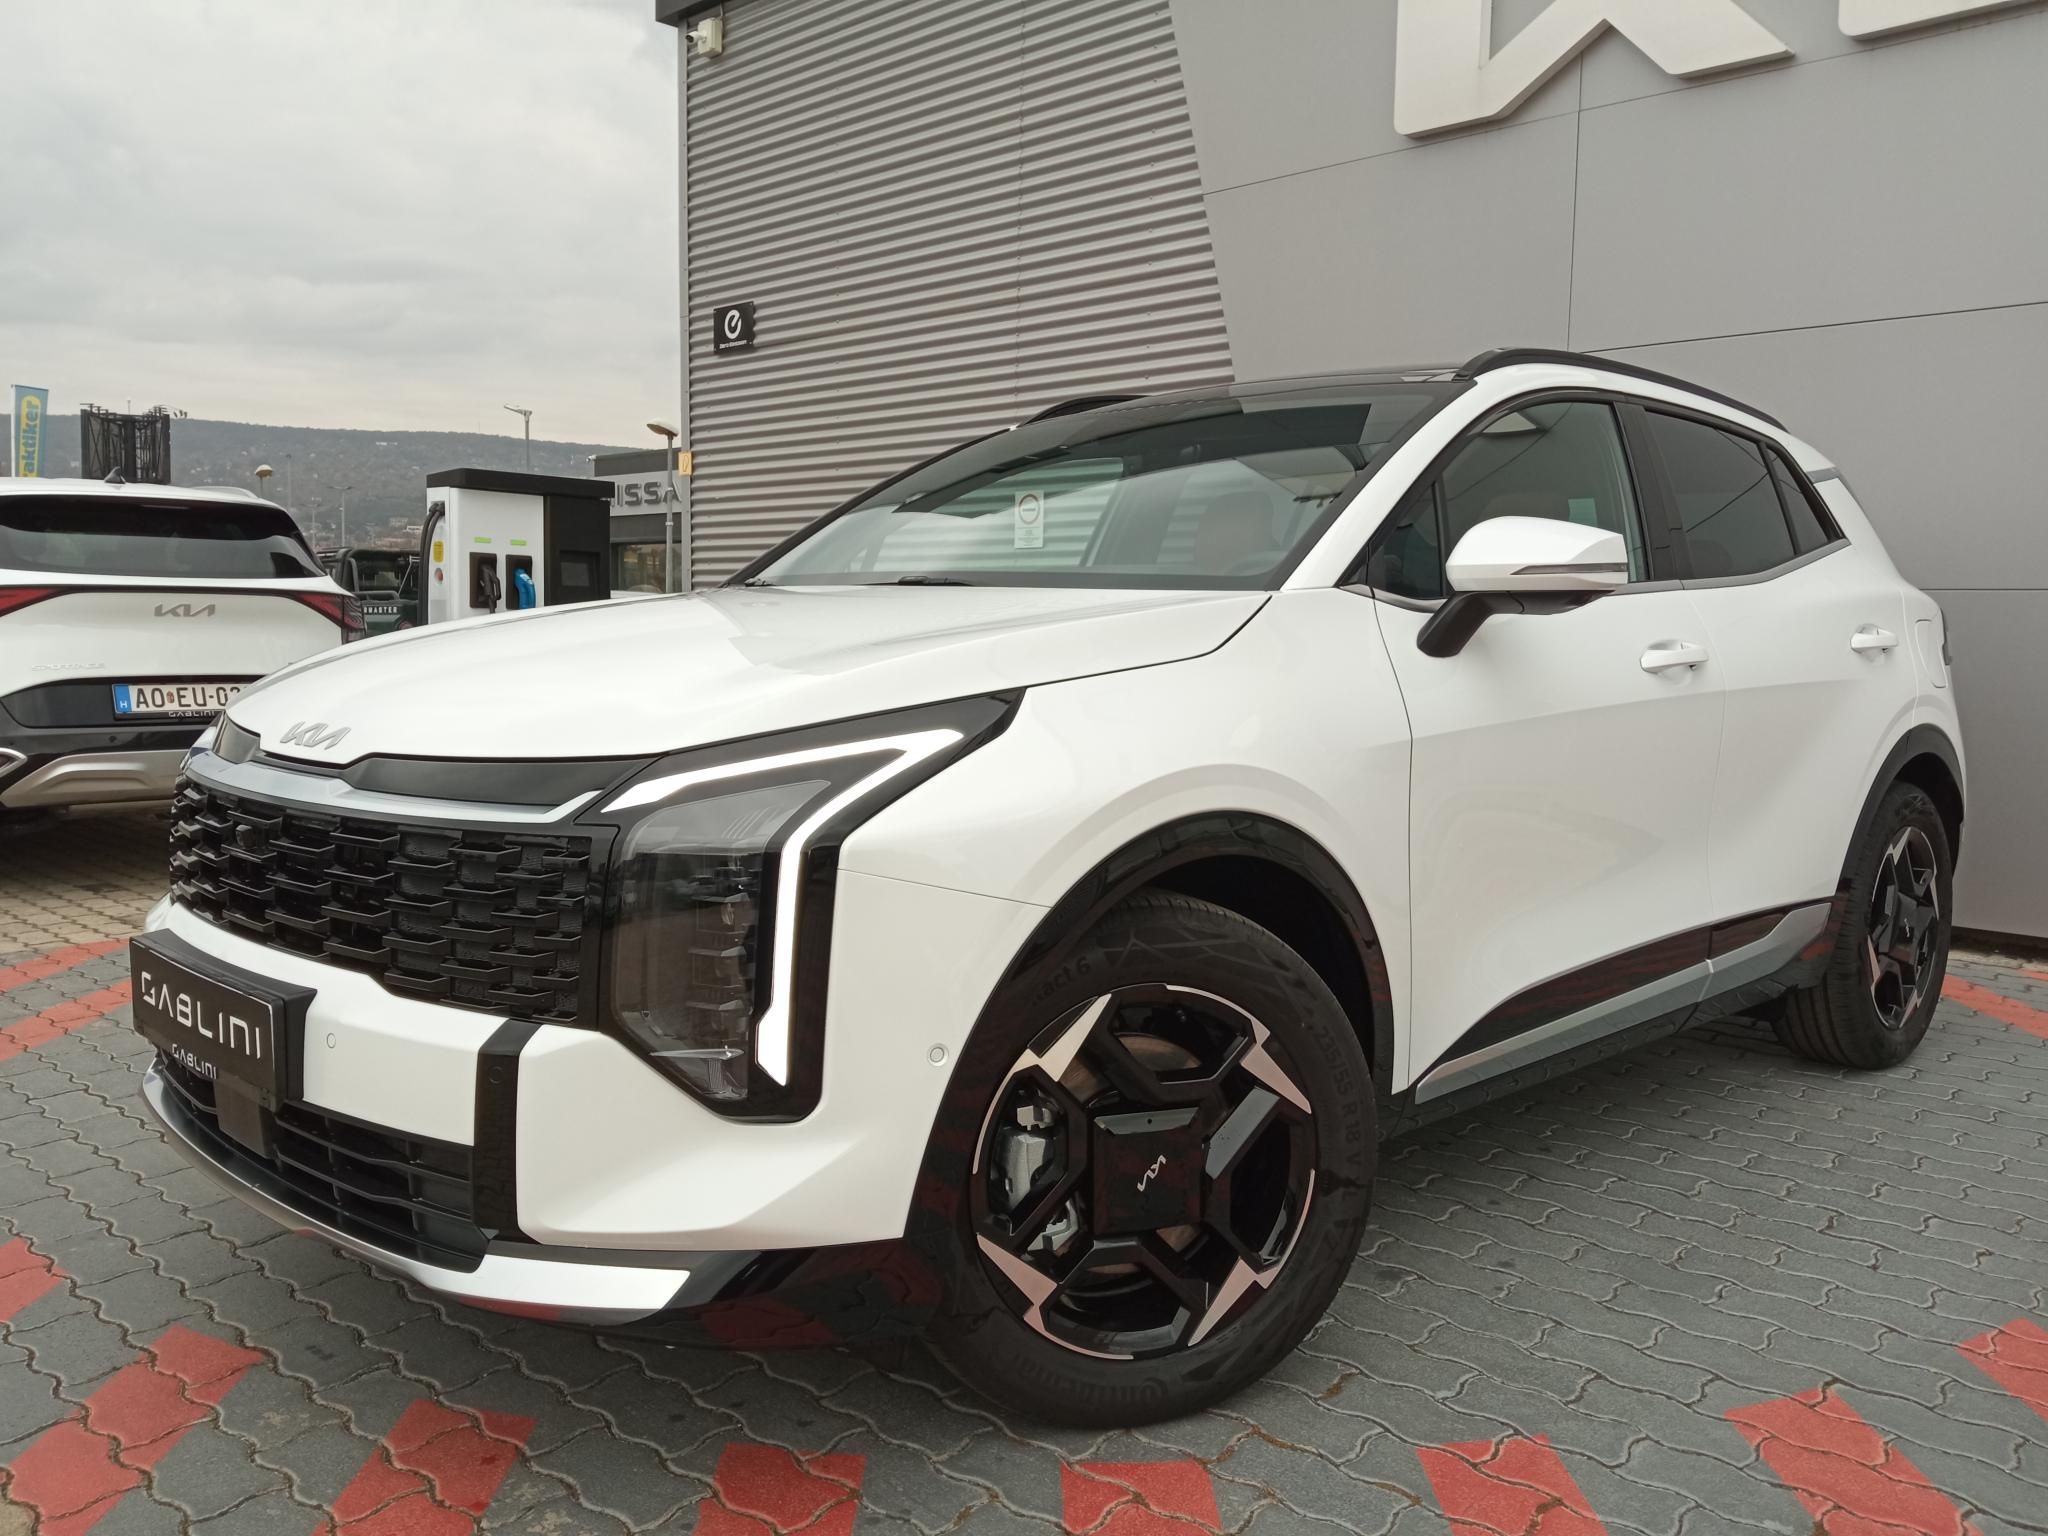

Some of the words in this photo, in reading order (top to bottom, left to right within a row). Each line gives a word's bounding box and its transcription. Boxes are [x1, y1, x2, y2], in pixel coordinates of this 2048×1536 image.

[22, 399, 39, 477] aktiker
[610, 481, 681, 508] ISSA
[119, 701, 128, 709] H
[141, 971, 261, 1060] GABLINI
[171, 1043, 218, 1080] GABLINI
